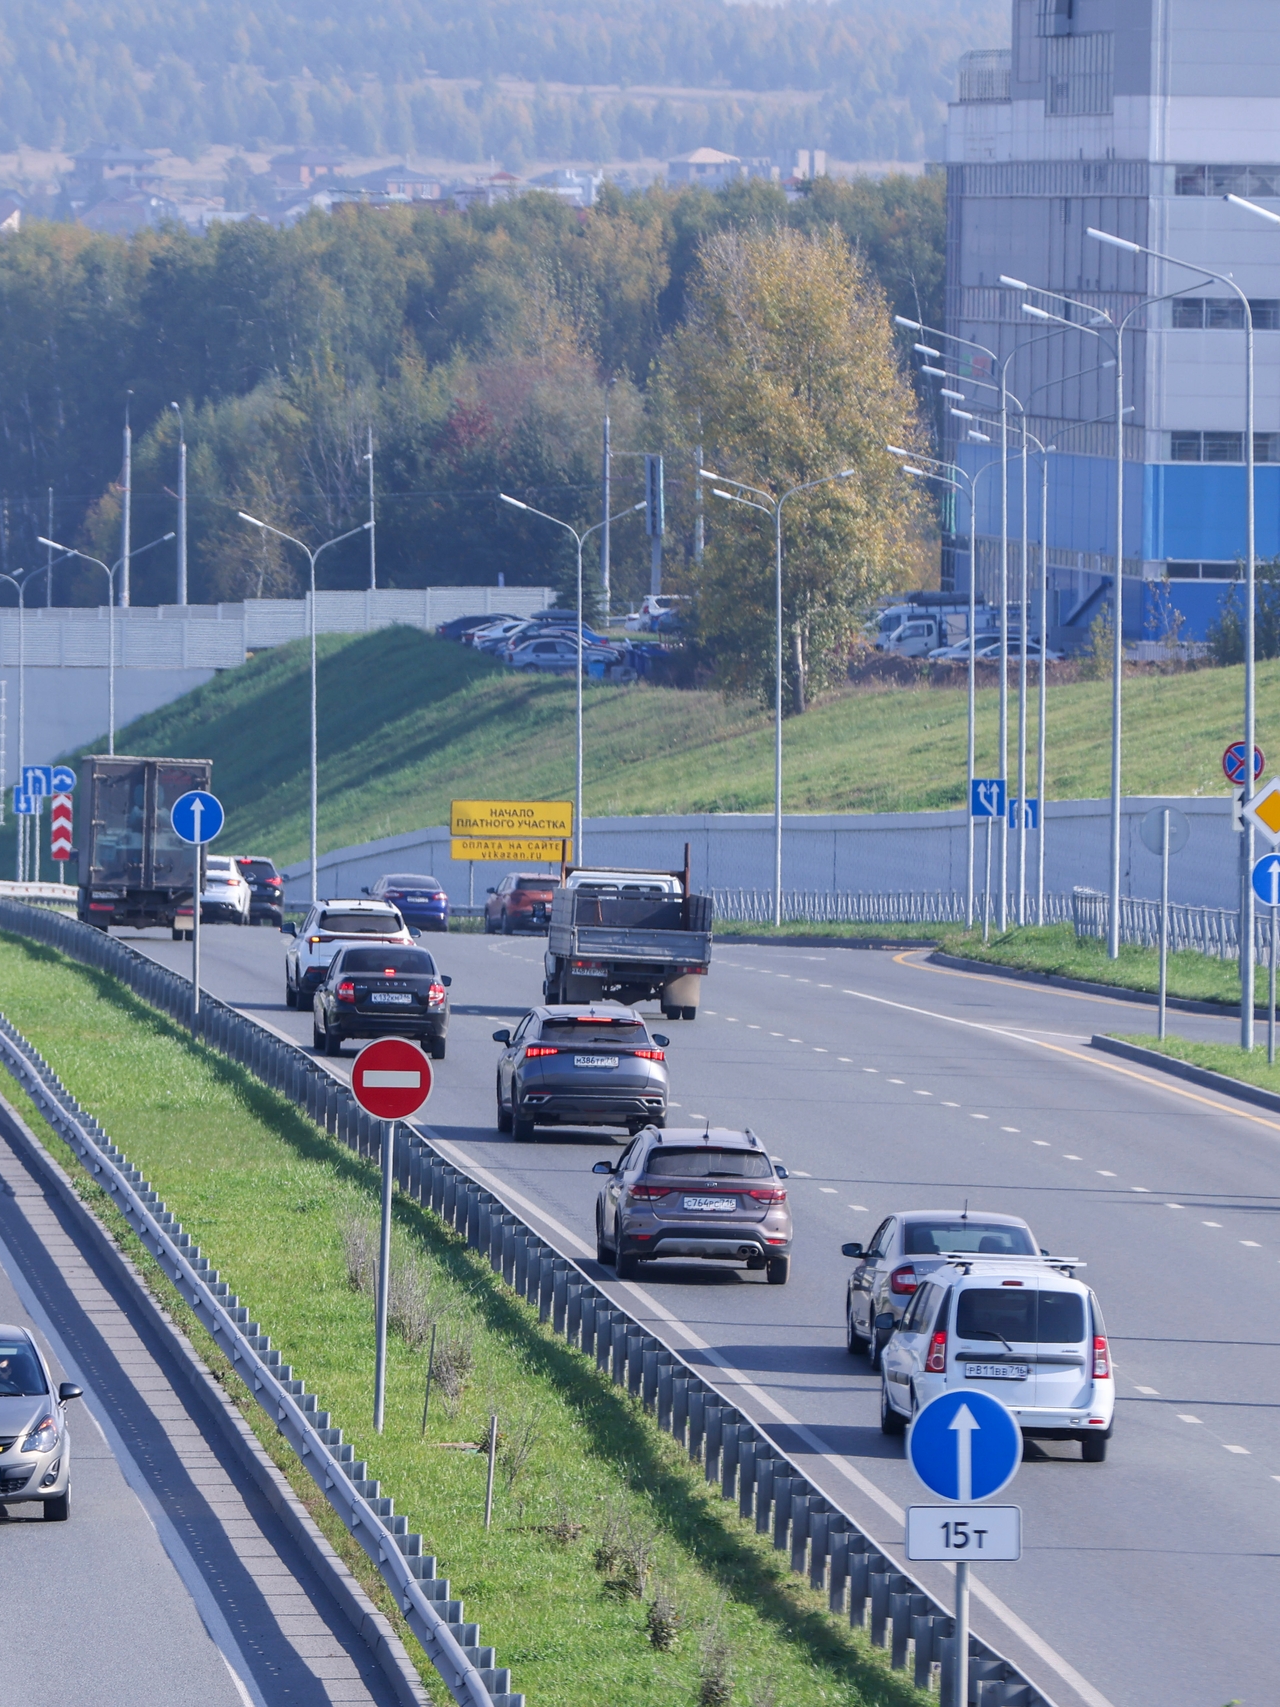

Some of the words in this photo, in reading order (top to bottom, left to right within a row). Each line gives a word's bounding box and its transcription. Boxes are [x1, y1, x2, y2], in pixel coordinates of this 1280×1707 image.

[490, 808, 534, 818] НАЧАЛО
[456, 819, 515, 828] ПЛАТНОГО
[517, 819, 566, 829] УЧАСТКА
[462, 841, 503, 850] ОПЛАТА
[508, 841, 522, 850] НА
[527, 841, 560, 850] САЙТЕ
[481, 850, 542, 860] vtkazan.ru
